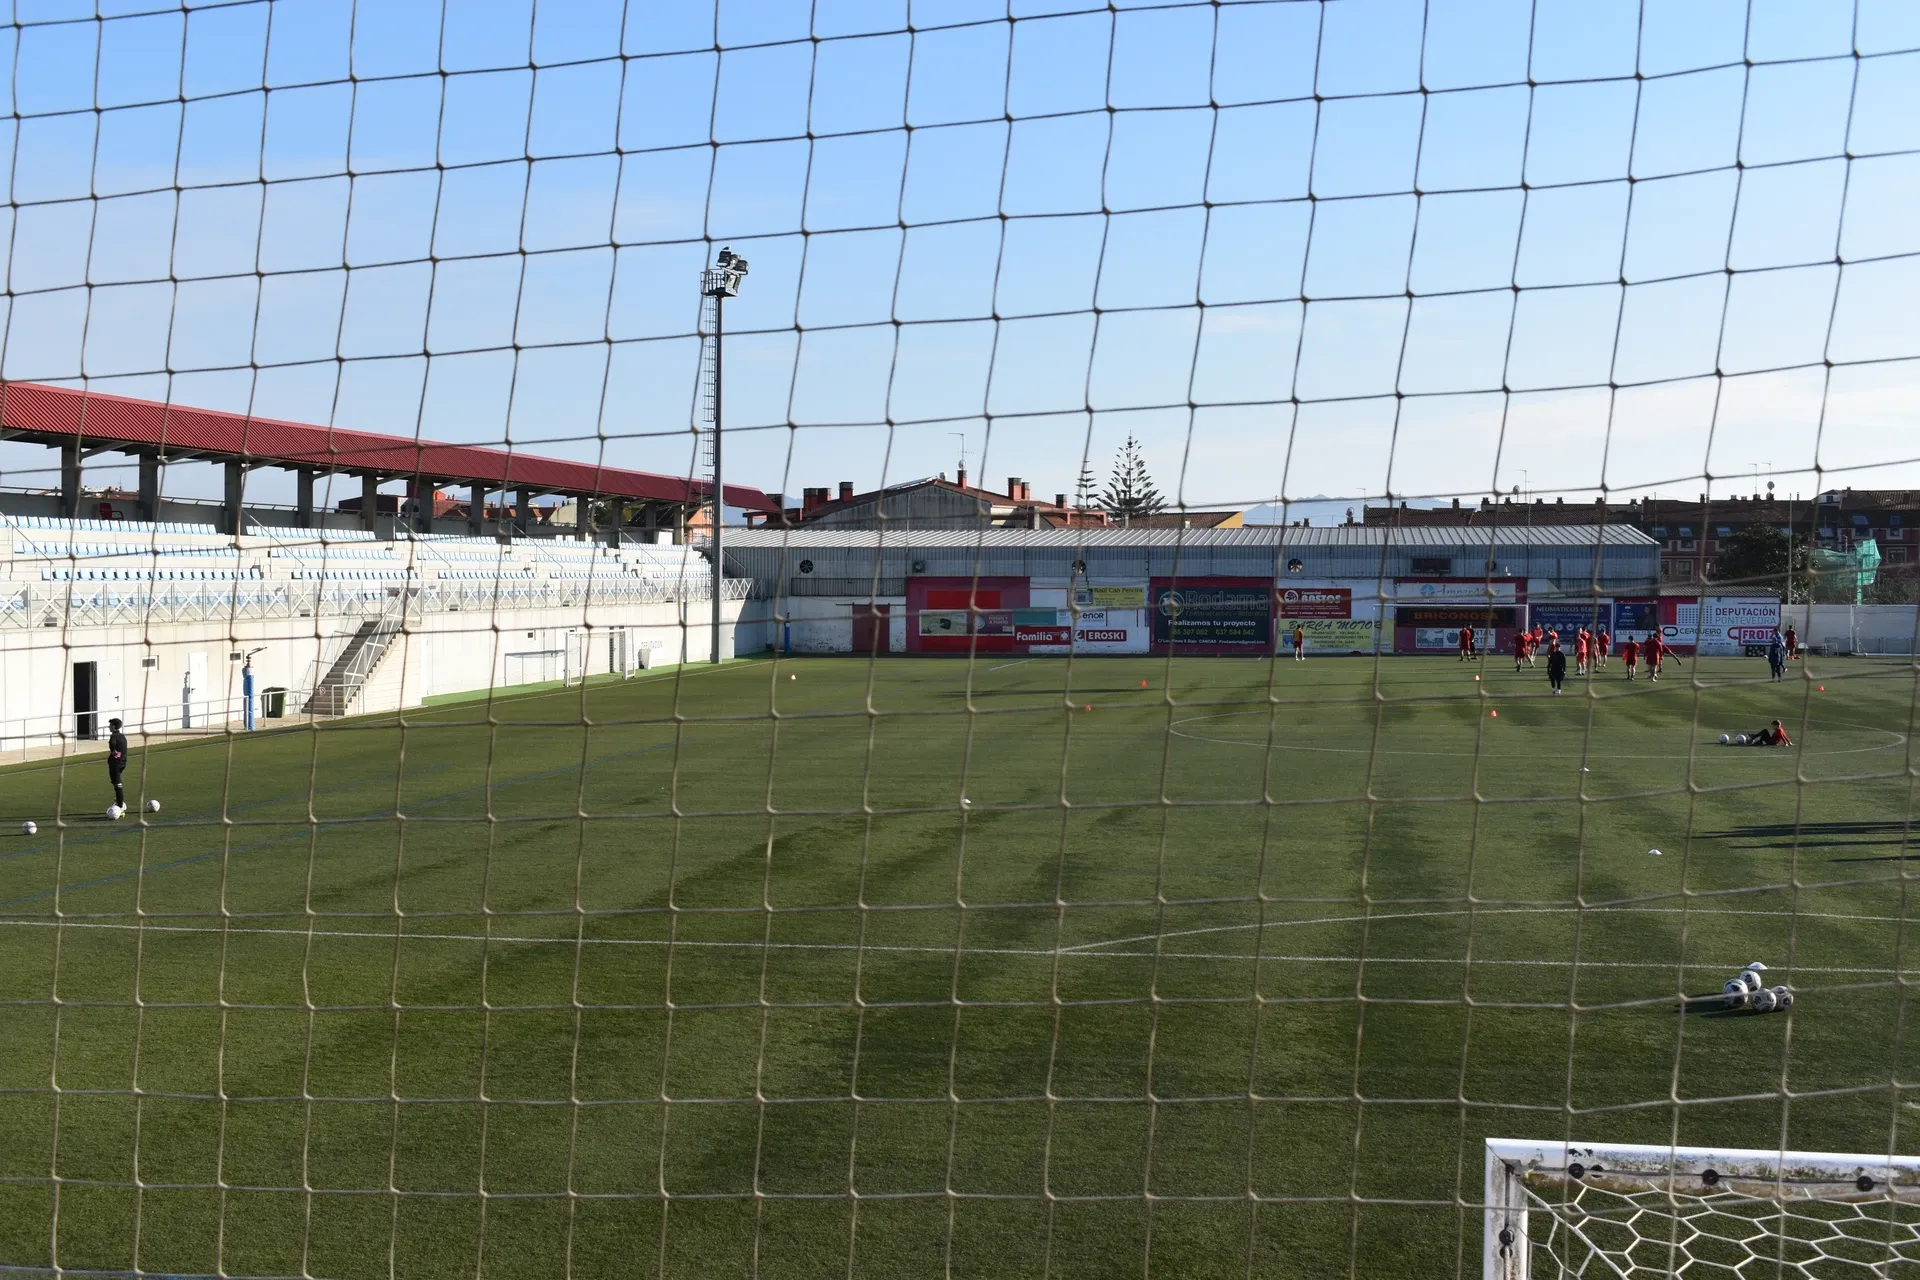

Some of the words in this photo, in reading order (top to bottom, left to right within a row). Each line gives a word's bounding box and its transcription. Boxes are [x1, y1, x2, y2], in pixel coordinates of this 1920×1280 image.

[1185, 590, 1268, 611] Rodama
[1301, 594, 1341, 604] BASTOS
[1414, 611, 1499, 619] BRICONOSA
[1716, 606, 1775, 616] DEPUTACIÓN
[1223, 619, 1256, 628] proyecto
[1289, 620, 1332, 630] BARCA
[1336, 620, 1383, 630] MOTOR
[1716, 616, 1776, 625] PONTEVEDRA
[1016, 631, 1053, 641] Familia
[1088, 632, 1123, 640] EROSKI
